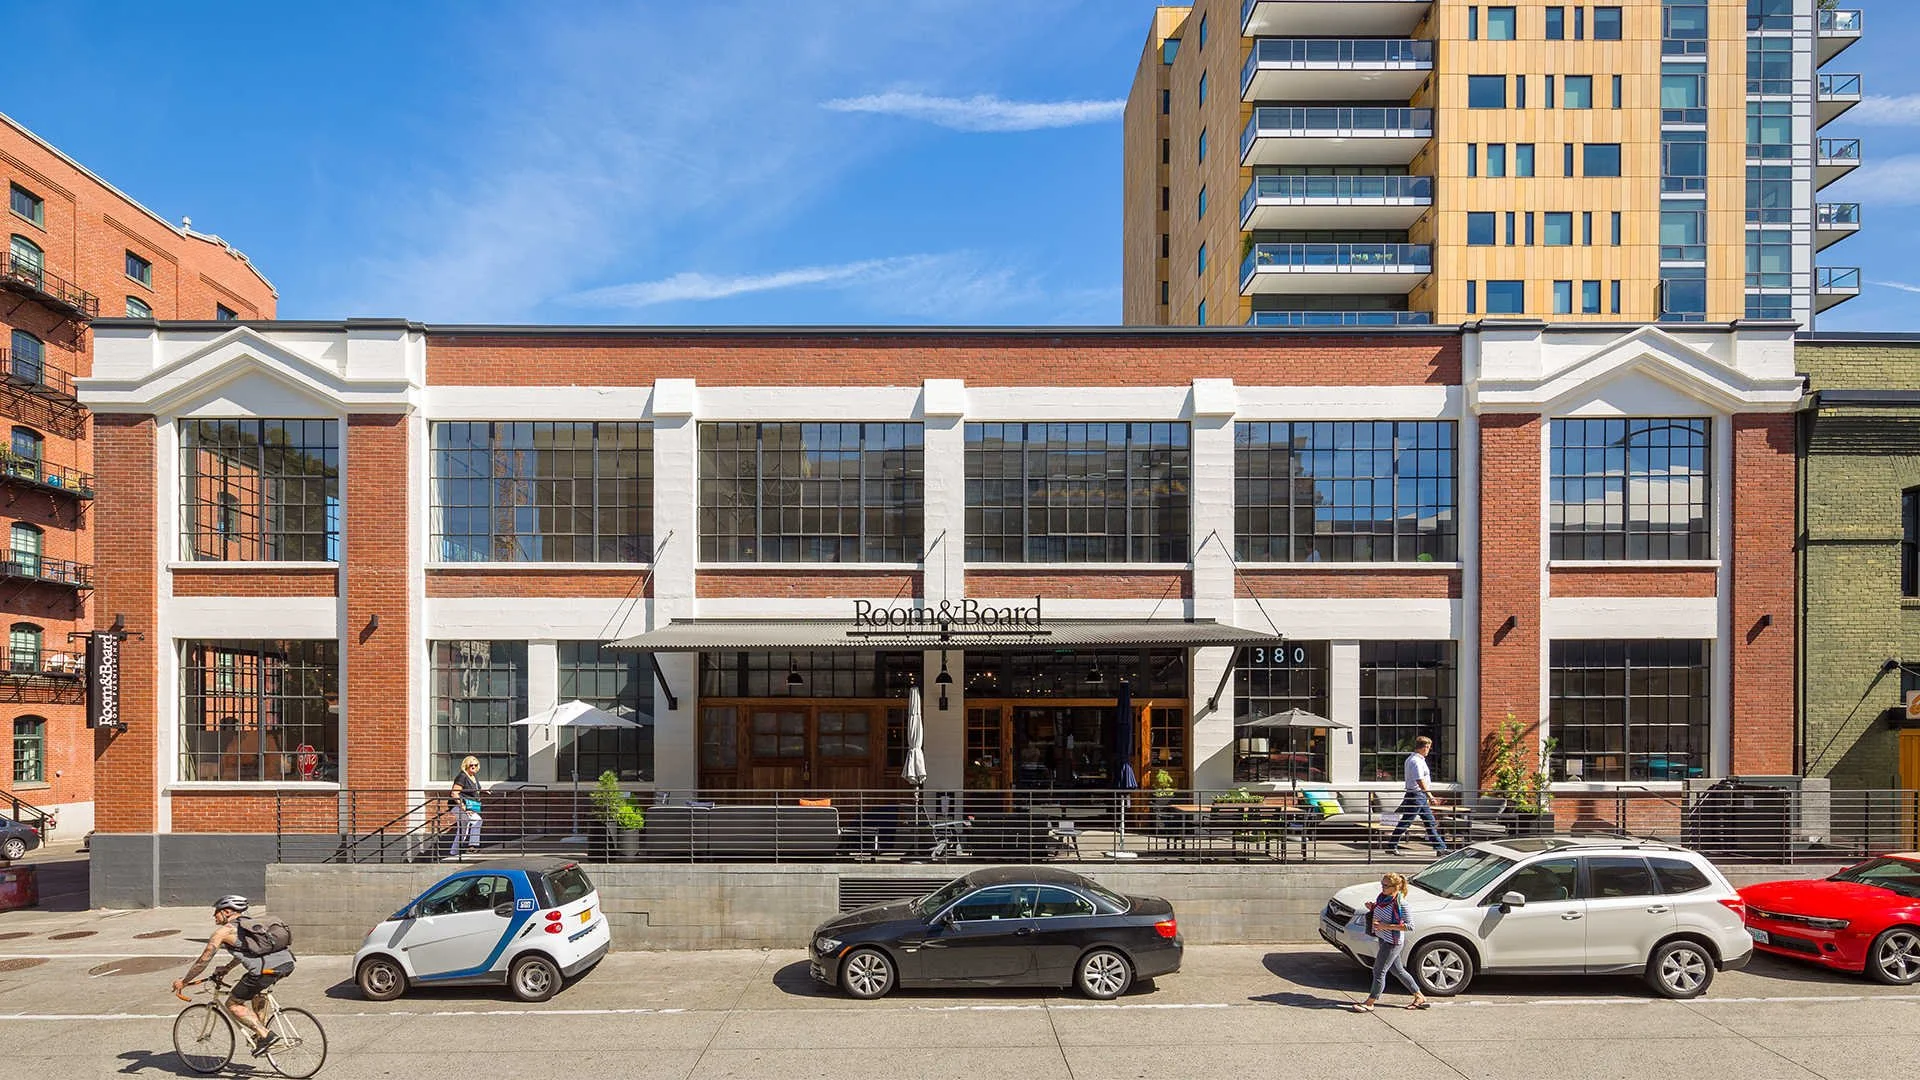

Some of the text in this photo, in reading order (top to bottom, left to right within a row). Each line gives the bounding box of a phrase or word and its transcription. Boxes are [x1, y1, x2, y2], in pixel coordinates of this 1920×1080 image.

[853, 595, 1041, 626] Room&Board
[1255, 647, 1305, 663] 380
[99, 634, 112, 726] Room&Board
